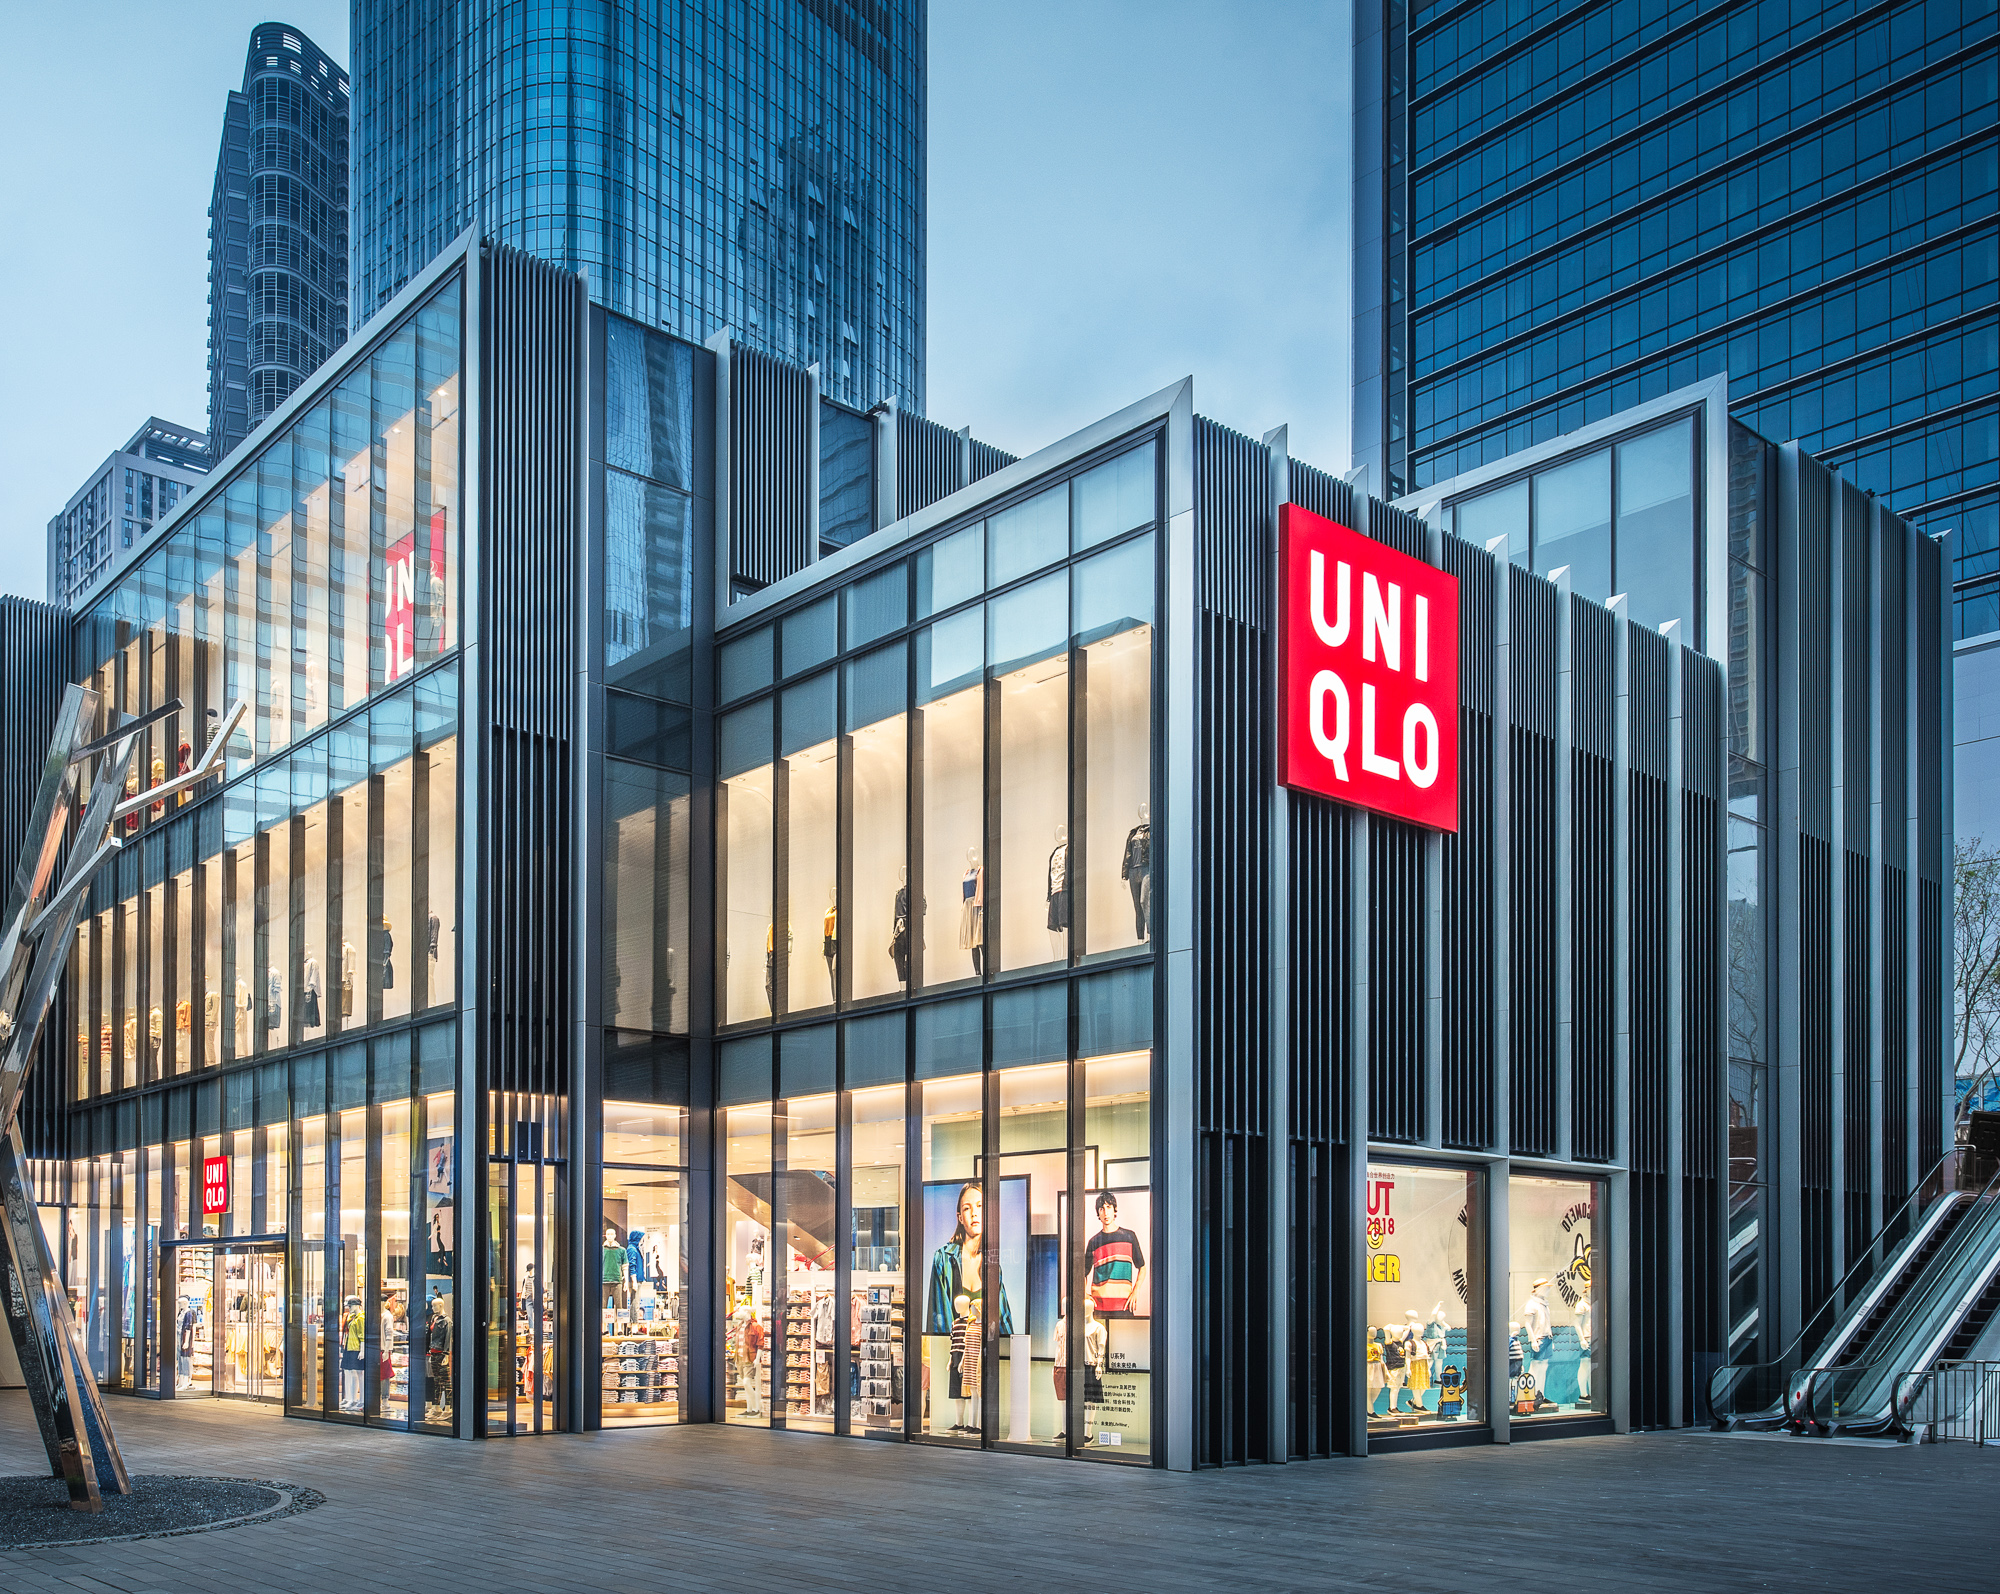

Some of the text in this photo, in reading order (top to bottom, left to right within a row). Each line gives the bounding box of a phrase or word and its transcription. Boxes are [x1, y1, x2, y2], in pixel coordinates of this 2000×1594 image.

[1310, 549, 1429, 683] UNI
[1309, 669, 1439, 789] QLO
[206, 1163, 223, 1184] UNI
[206, 1186, 224, 1210] QLO
[1367, 1180, 1394, 1215] UT
[1367, 1217, 1395, 1236] 2018
